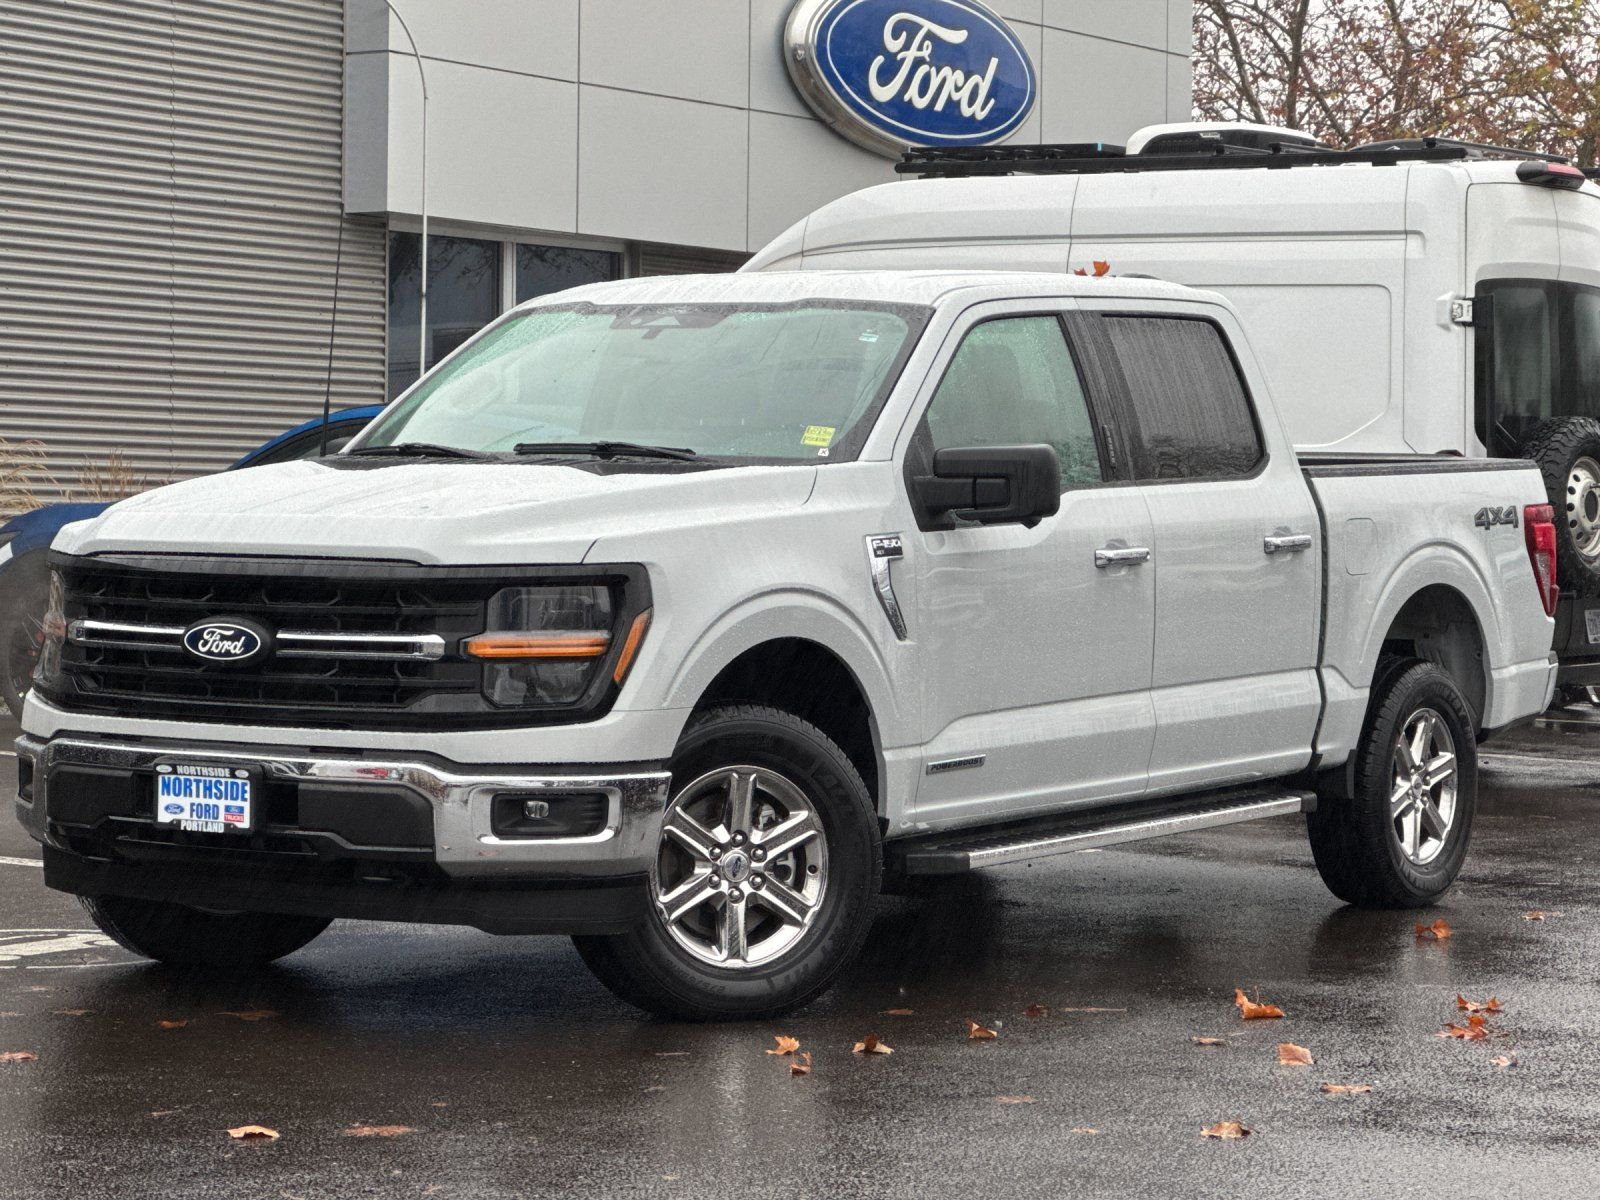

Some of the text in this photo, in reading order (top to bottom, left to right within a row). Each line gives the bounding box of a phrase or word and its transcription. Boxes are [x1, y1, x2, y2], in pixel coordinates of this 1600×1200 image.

[868, 12, 998, 120] Ford
[198, 628, 246, 654] Ford
[176, 765, 231, 778] NORTHSIDE
[161, 776, 248, 802] NORTHSIDE
[189, 802, 220, 820] FORD
[224, 814, 244, 822] TRUCKS
[180, 819, 225, 833] PORTLAND
